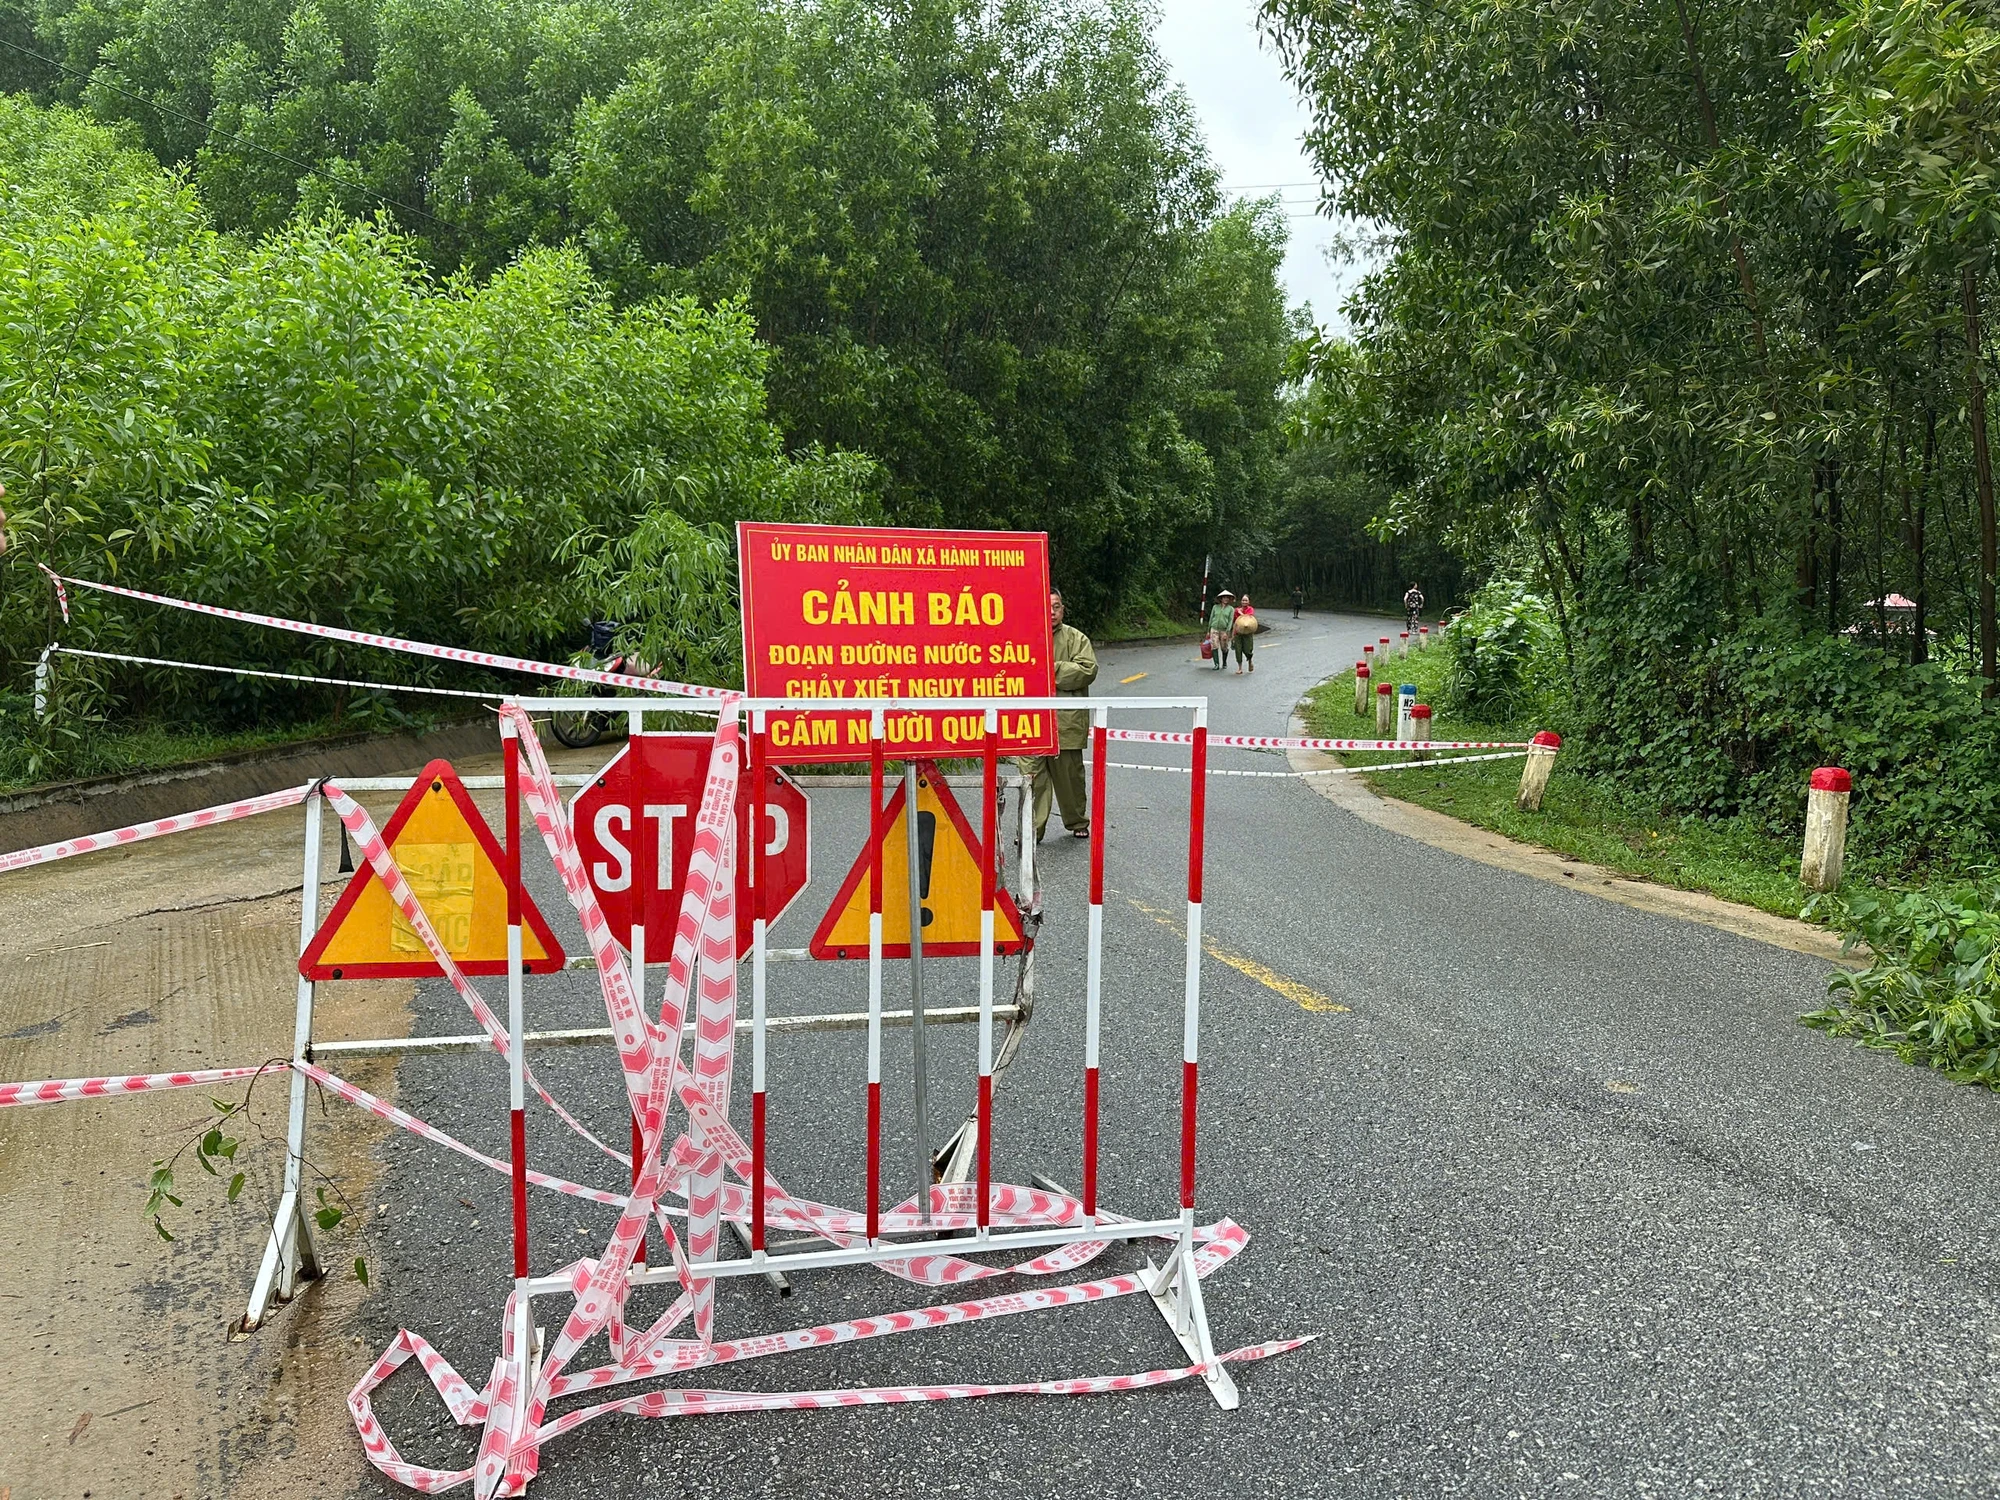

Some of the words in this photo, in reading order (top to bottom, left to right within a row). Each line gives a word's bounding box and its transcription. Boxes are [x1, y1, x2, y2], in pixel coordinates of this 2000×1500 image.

[771, 537, 791, 561] ỦY
[796, 543, 829, 563] BAN
[834, 543, 877, 564] NHÂN
[881, 544, 912, 565] DÂN
[916, 545, 936, 566] XÃ
[940, 544, 980, 567] HÀNH
[983, 549, 1025, 571] THỊNH
[802, 579, 914, 626] CẢNH
[928, 586, 1004, 626] BÁO
[768, 644, 834, 670] ĐOẠN
[840, 640, 917, 665] ĐƯỜNG
[924, 640, 982, 665] NƯỚC
[988, 640, 1036, 666] SÂU,
[785, 672, 845, 698] CHẢY
[853, 672, 901, 698] XIẾT
[908, 678, 966, 698] NGUY
[973, 669, 1025, 697] HIỂM
[771, 710, 838, 747] CẤM
[942, 715, 987, 744] QUA
[1002, 713, 1041, 745] LẠI
[718, 778, 726, 788] NOT
[712, 789, 722, 811] ALLOWED
[708, 812, 716, 824] AREA
[593, 803, 790, 893] STP
[610, 990, 620, 1010] ALLOWED
[616, 1011, 624, 1020] NOT
[652, 1068, 660, 1090] ALLOWED
